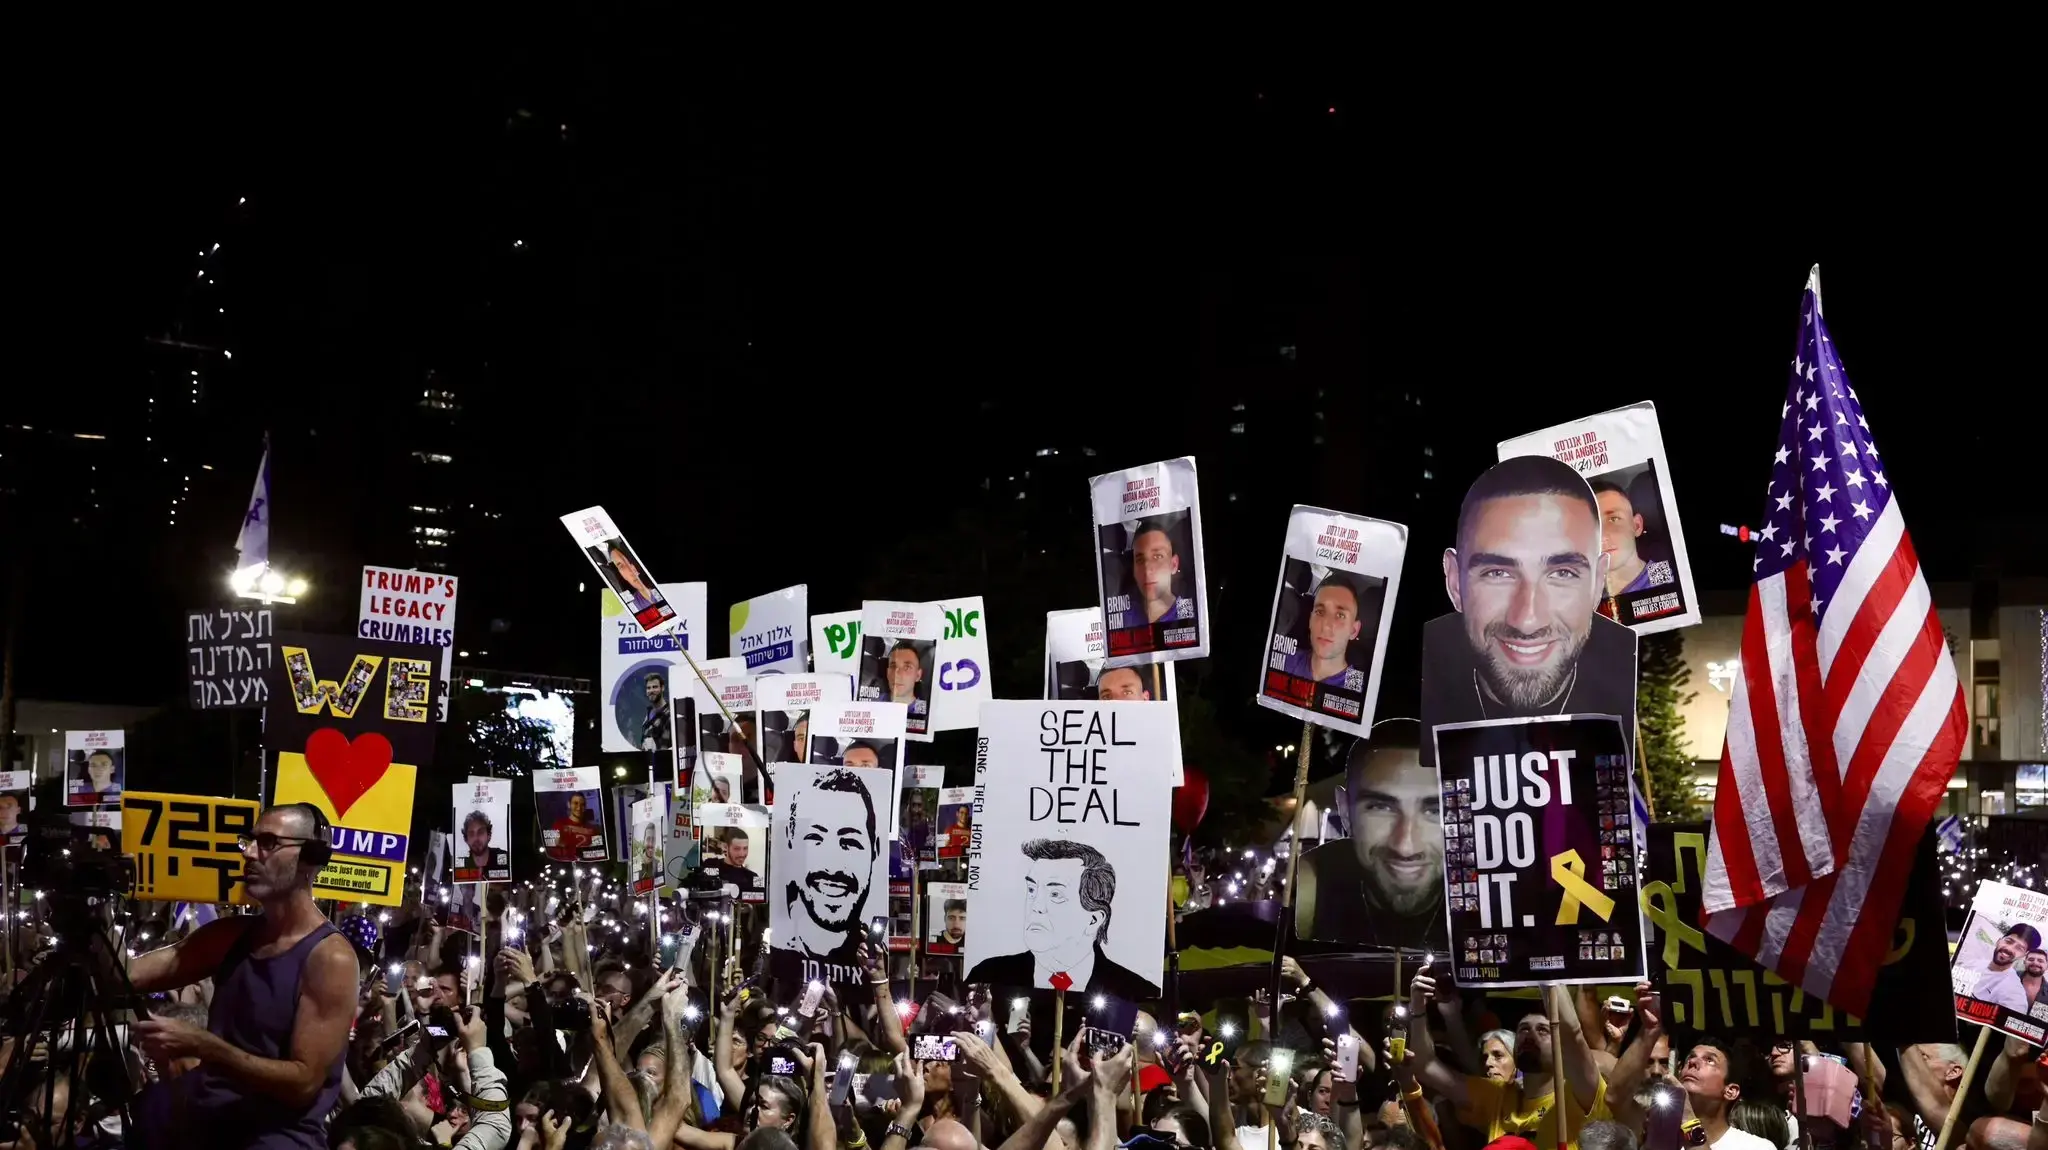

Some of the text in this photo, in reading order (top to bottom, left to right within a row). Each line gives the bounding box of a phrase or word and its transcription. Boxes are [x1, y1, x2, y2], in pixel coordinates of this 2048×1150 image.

[1552, 440, 1608, 462] ATAN ANGREST
[1317, 534, 1362, 553] MATAN ANGREST
[365, 569, 454, 598] TRUMP'S
[370, 595, 446, 621] LEGACY
[1107, 594, 1131, 613] BRING
[1633, 597, 1680, 616] FAMILIES FORUM
[188, 608, 272, 642] תציל את
[359, 619, 452, 648] CRUMBLES
[618, 620, 641, 635] הל
[1109, 612, 1124, 630] HIM
[625, 639, 663, 651] שיחזור
[741, 624, 793, 650] אלון אהל
[1273, 633, 1298, 656] BRING
[190, 643, 272, 676] המדינה
[745, 643, 789, 666] עד שיחזור
[1270, 651, 1286, 671] HIM
[281, 646, 431, 723] WE
[860, 686, 880, 699] BRING
[1040, 710, 1137, 746] SEAL
[1041, 748, 1108, 785] THE
[1470, 749, 1577, 811] JUST
[968, 737, 990, 891] BRING THEM HOME NOW
[1030, 786, 1140, 827] DEAL
[124, 798, 255, 853] 729
[331, 827, 398, 856] UMP
[1473, 811, 1536, 869] DO
[320, 876, 372, 890] an entire world
[339, 864, 353, 876] just
[353, 867, 368, 877] one
[368, 868, 380, 879] life
[1477, 872, 1536, 929] IT.
[2003, 897, 2018, 908] GALI
[2017, 901, 2031, 911] AND
[824, 962, 864, 986] איתי
[1954, 994, 1999, 1020] ME NOW!
